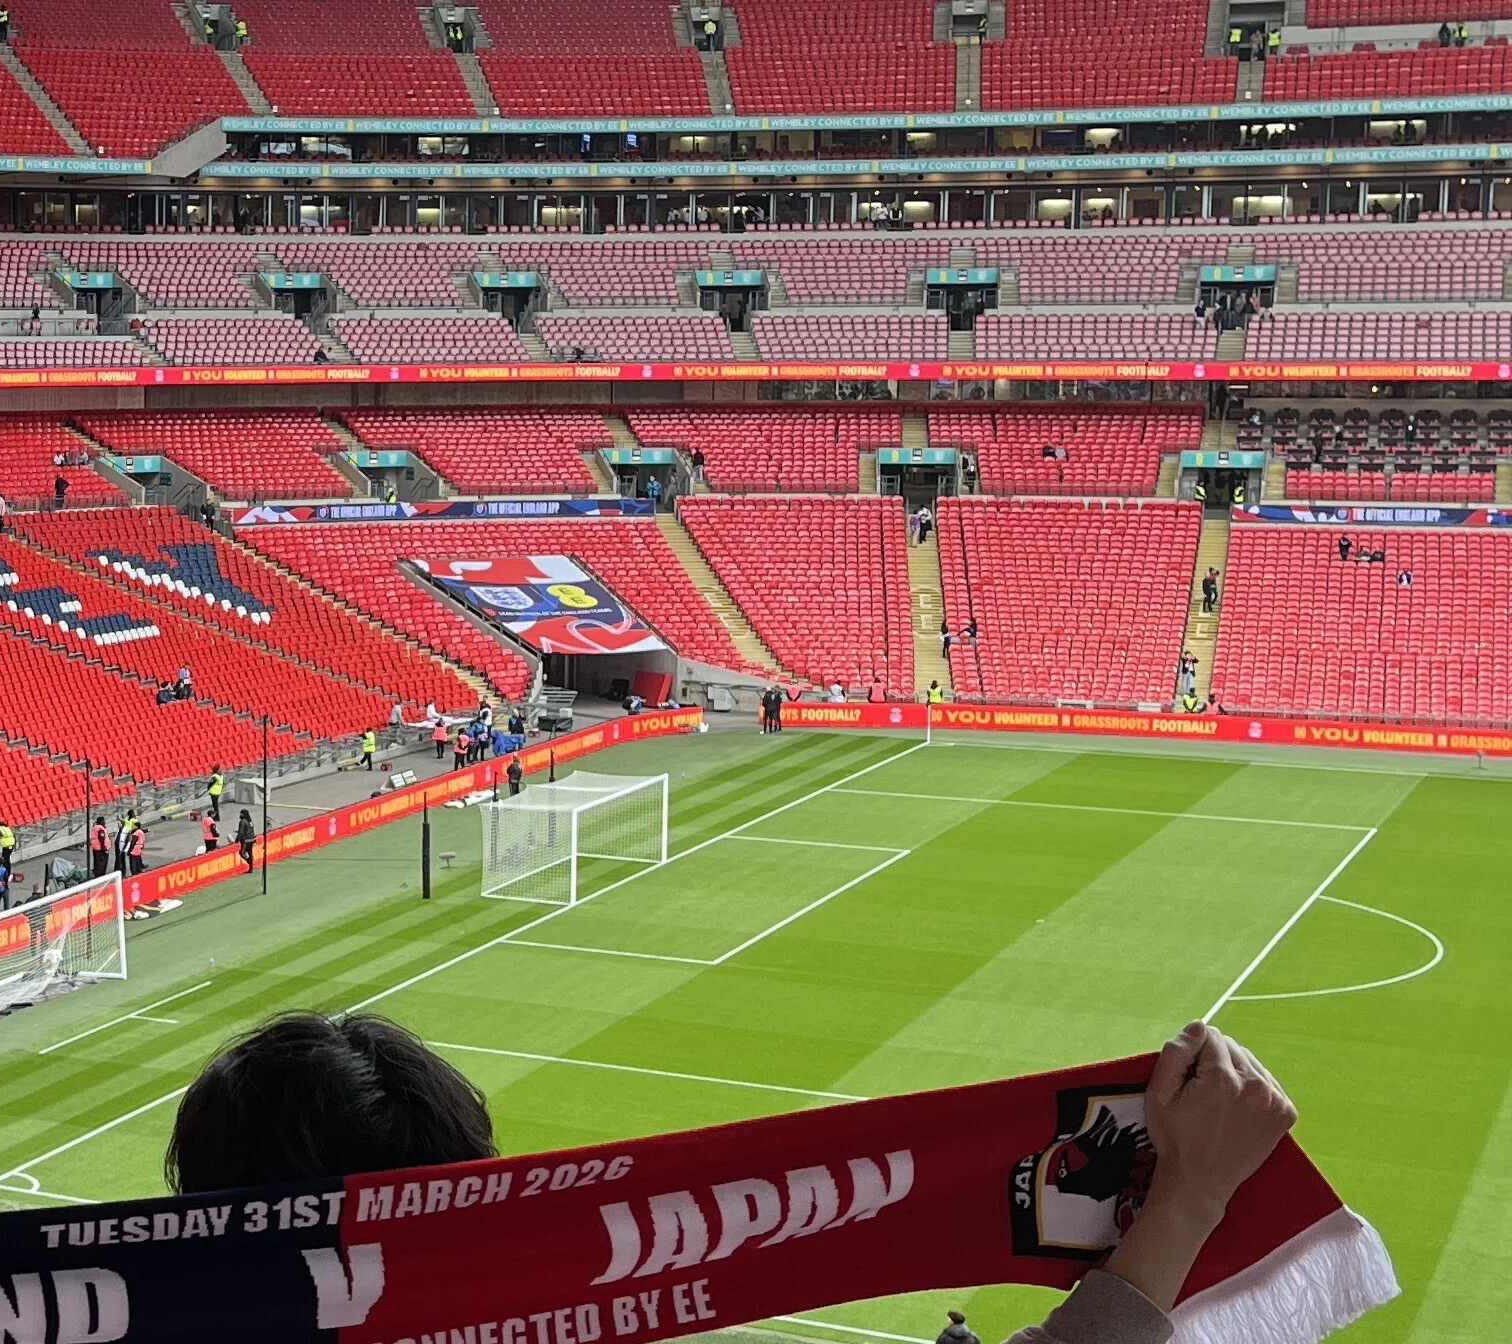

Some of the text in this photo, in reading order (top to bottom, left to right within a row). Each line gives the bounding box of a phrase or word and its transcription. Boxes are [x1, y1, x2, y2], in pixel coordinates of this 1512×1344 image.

[192, 370, 224, 380] YOU
[430, 368, 462, 378] YOU
[685, 366, 718, 376] YOU
[955, 366, 990, 376] YOU
[1242, 366, 1280, 376] YOU
[801, 708, 861, 723] FOOTBALL?
[946, 709, 990, 723] YOU
[994, 711, 1059, 727] VOLUNTEER
[1073, 715, 1149, 731] GRASSROOTS
[1152, 718, 1217, 735] FOOTBALL?
[1311, 727, 1359, 741] YOU
[1364, 729, 1433, 746] VOLUNTEER
[168, 867, 196, 889] YOU
[41, 1156, 633, 1248] TUESDAY 31ST MARCH 2026
[301, 1243, 385, 1330] V
[589, 1150, 914, 1286] JAPAN
[612, 1289, 661, 1336] BY
[673, 1278, 716, 1324] EE
